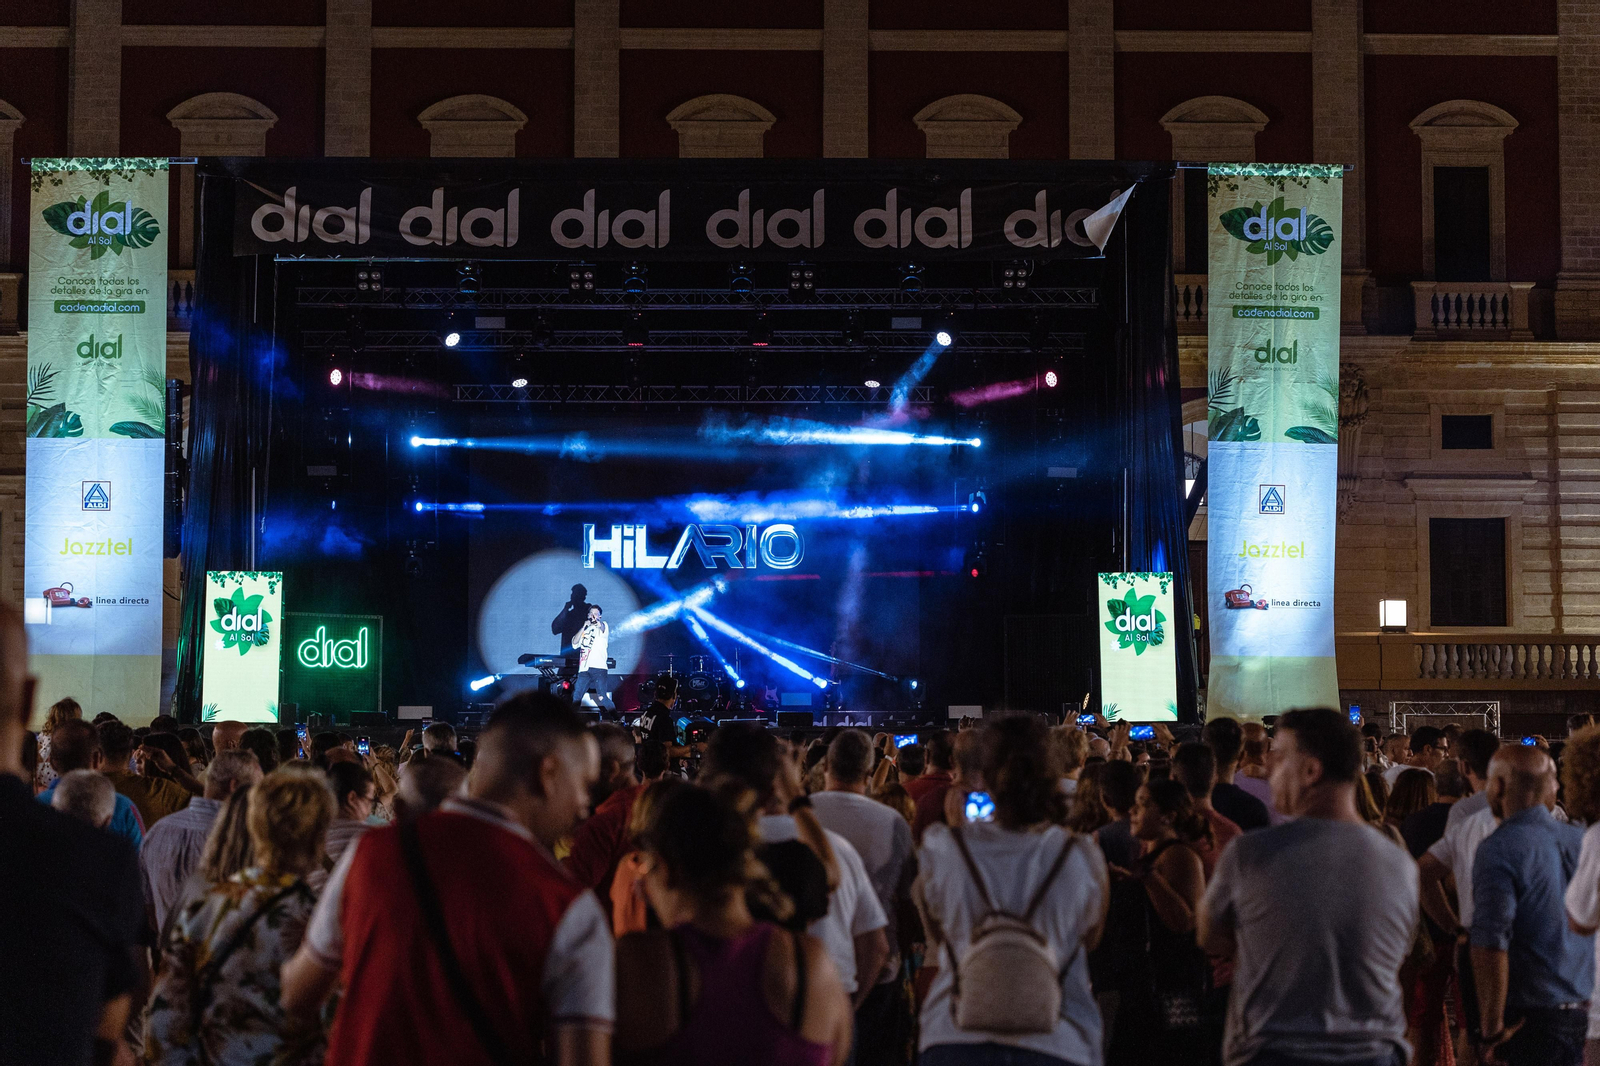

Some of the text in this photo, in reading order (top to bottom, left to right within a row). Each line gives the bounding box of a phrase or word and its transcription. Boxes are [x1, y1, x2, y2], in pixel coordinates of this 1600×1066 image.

[66, 200, 132, 235] dial
[251, 186, 1120, 249] dial dial dial dial dial dia
[1243, 205, 1307, 241] dial
[88, 236, 112, 245] Al Sol
[1264, 242, 1288, 251] Al Sol
[57, 276, 140, 285] Conoce todos los
[1235, 282, 1314, 291] Conoce todos los
[50, 286, 86, 294] detalles
[115, 286, 133, 298] gira
[1229, 291, 1263, 300] detalles
[1265, 292, 1278, 300] de
[1280, 292, 1289, 300] la
[1290, 293, 1308, 303] gira
[60, 302, 140, 312] cadenadial.com
[1237, 308, 1315, 318] cadenadial.com
[76, 333, 123, 359] dial
[1254, 338, 1298, 364] dial
[59, 537, 133, 556] Jazztel
[1238, 540, 1305, 559] Jazztel
[119, 596, 149, 605] directa
[1293, 599, 1321, 607] directa
[220, 606, 263, 632] dial
[1115, 606, 1156, 632] dial
[229, 633, 254, 642] Al Sol
[1125, 633, 1150, 642] Al Sol
[298, 625, 368, 669] dial
